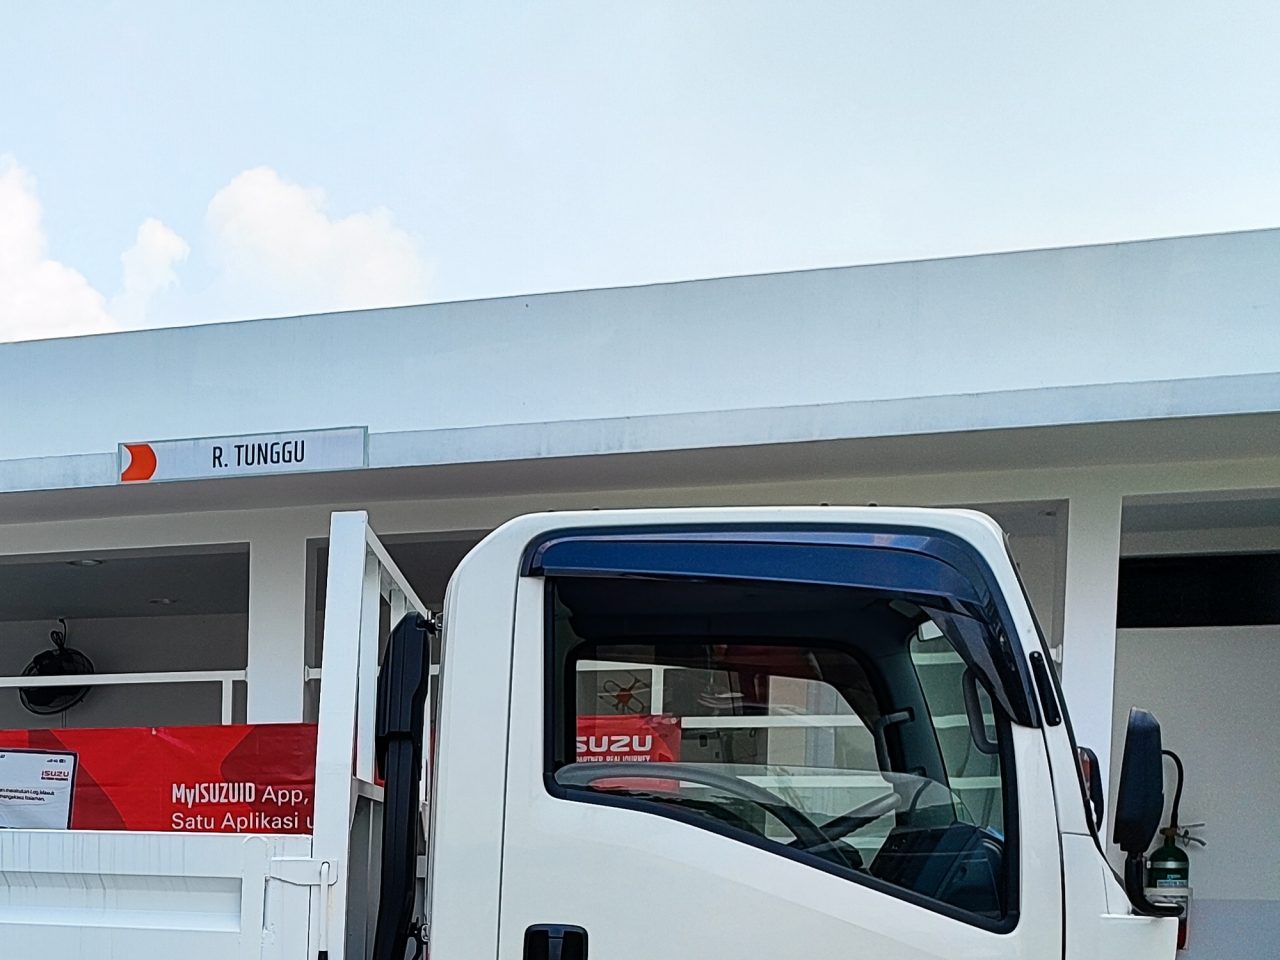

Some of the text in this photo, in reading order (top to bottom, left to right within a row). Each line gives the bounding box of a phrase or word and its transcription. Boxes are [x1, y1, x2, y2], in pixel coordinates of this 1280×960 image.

[212, 440, 305, 468] R. TUNGGU
[172, 782, 309, 809] MyISUZUID App,
[172, 812, 214, 830] Satu
[221, 811, 299, 832] Aplikasi
